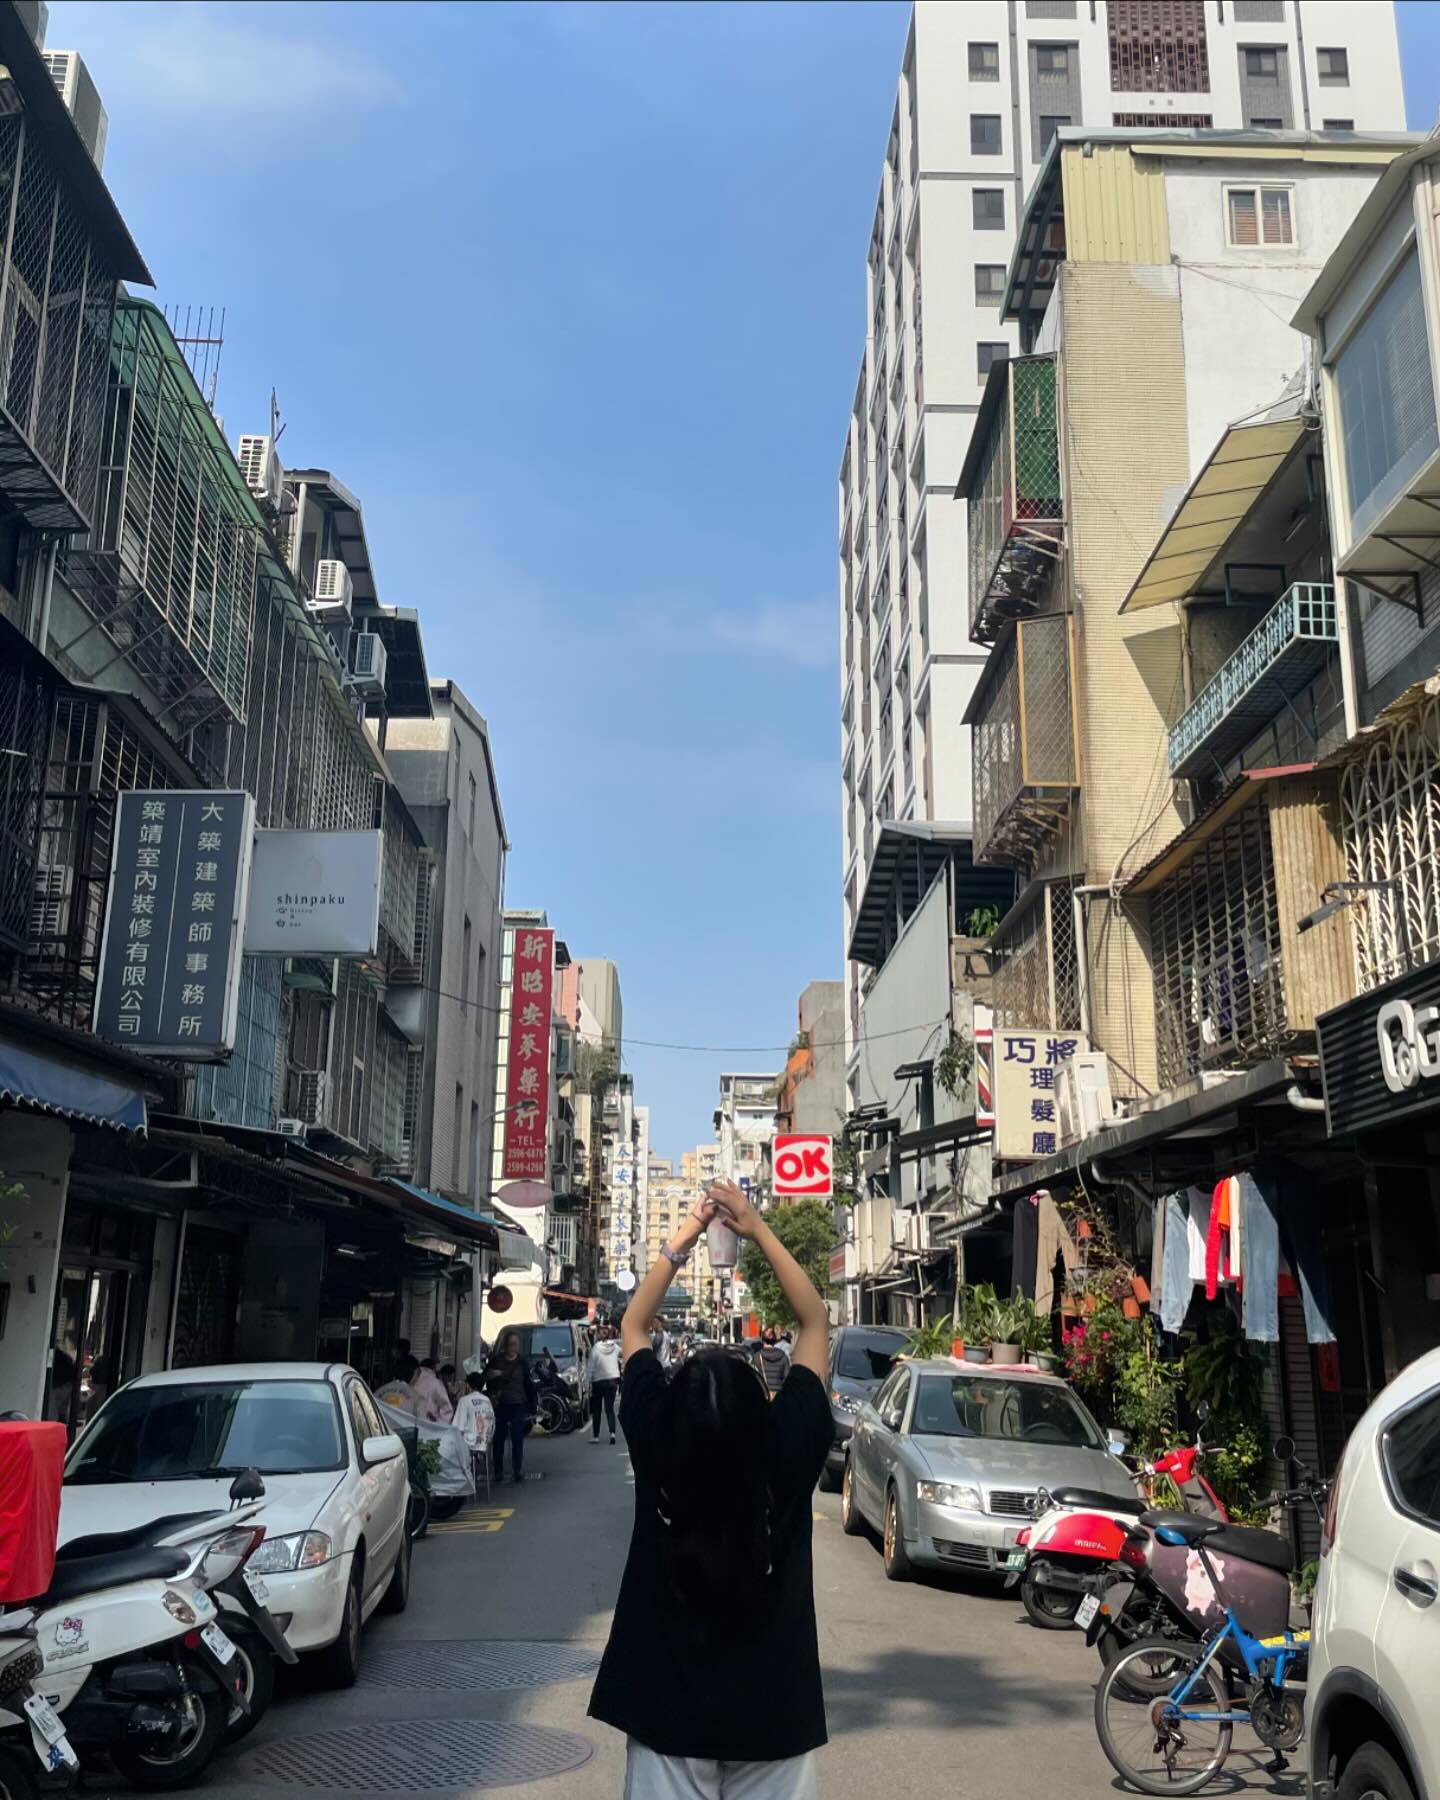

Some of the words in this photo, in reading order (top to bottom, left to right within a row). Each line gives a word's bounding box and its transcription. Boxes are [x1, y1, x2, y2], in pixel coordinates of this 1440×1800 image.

[117, 800, 167, 1036] 築靖室內裝修有限公司
[176, 801, 226, 1038] 大築建築師事務所
[276, 893, 346, 907] shinpaku
[1029, 1067, 1057, 1154] 理髮廳
[775, 1146, 830, 1182] OK
